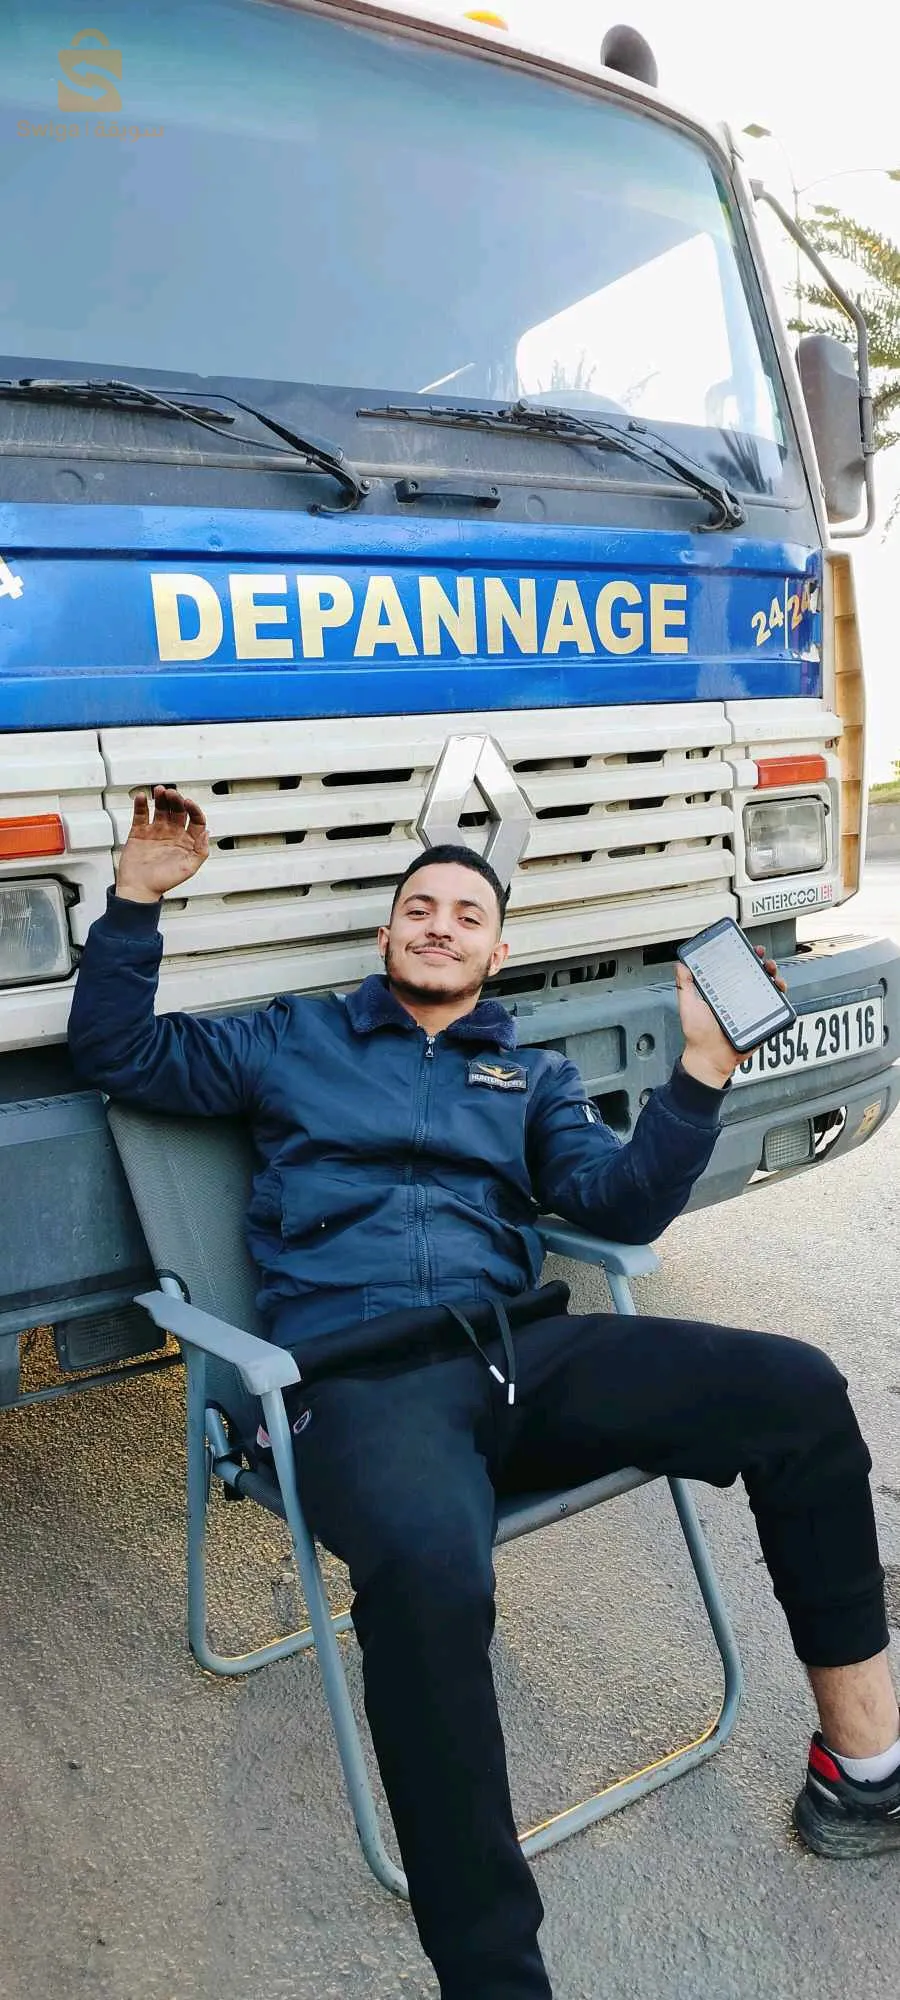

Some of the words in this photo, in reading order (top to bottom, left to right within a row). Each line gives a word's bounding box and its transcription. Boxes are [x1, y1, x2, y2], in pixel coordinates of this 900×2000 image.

[151, 573, 688, 662] DEPANNAGE
[815, 1010, 850, 1058] 291
[856, 1005, 875, 1047] 16
